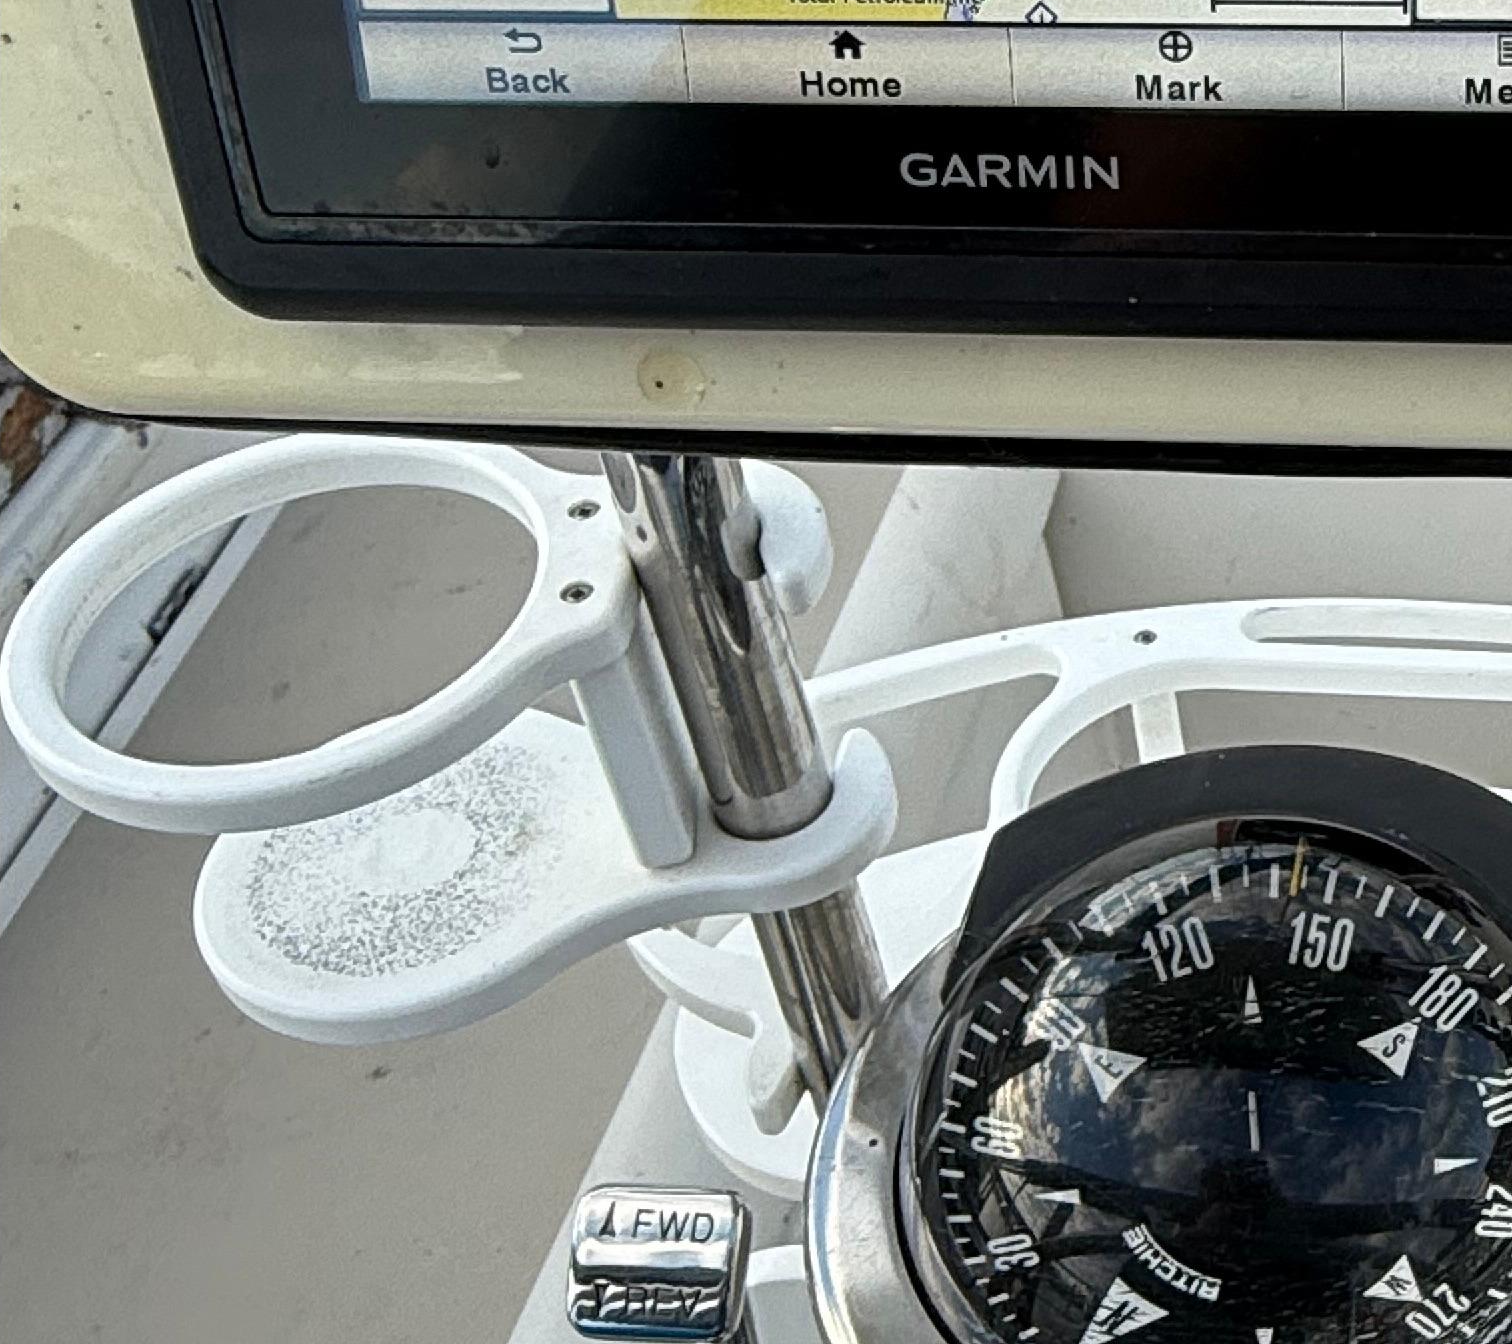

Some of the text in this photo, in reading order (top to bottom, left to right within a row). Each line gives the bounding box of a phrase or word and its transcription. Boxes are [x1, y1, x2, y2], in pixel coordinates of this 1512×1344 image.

[486, 67, 570, 94] Back
[800, 70, 902, 98] Home
[1135, 74, 1224, 102] Mark
[899, 152, 1120, 190] GARMIN
[1141, 915, 1215, 983] 120
[1288, 910, 1355, 972] 150
[1407, 965, 1479, 1033] 180
[1382, 1033, 1406, 1058] S
[1094, 1053, 1124, 1080] E
[970, 1115, 1024, 1159] 60
[631, 1207, 715, 1243] FWD
[987, 1233, 1040, 1272] 30
[1121, 1223, 1223, 1302] RITCHIE
[623, 1285, 702, 1319] REV
[1404, 1282, 1472, 1340] 270
